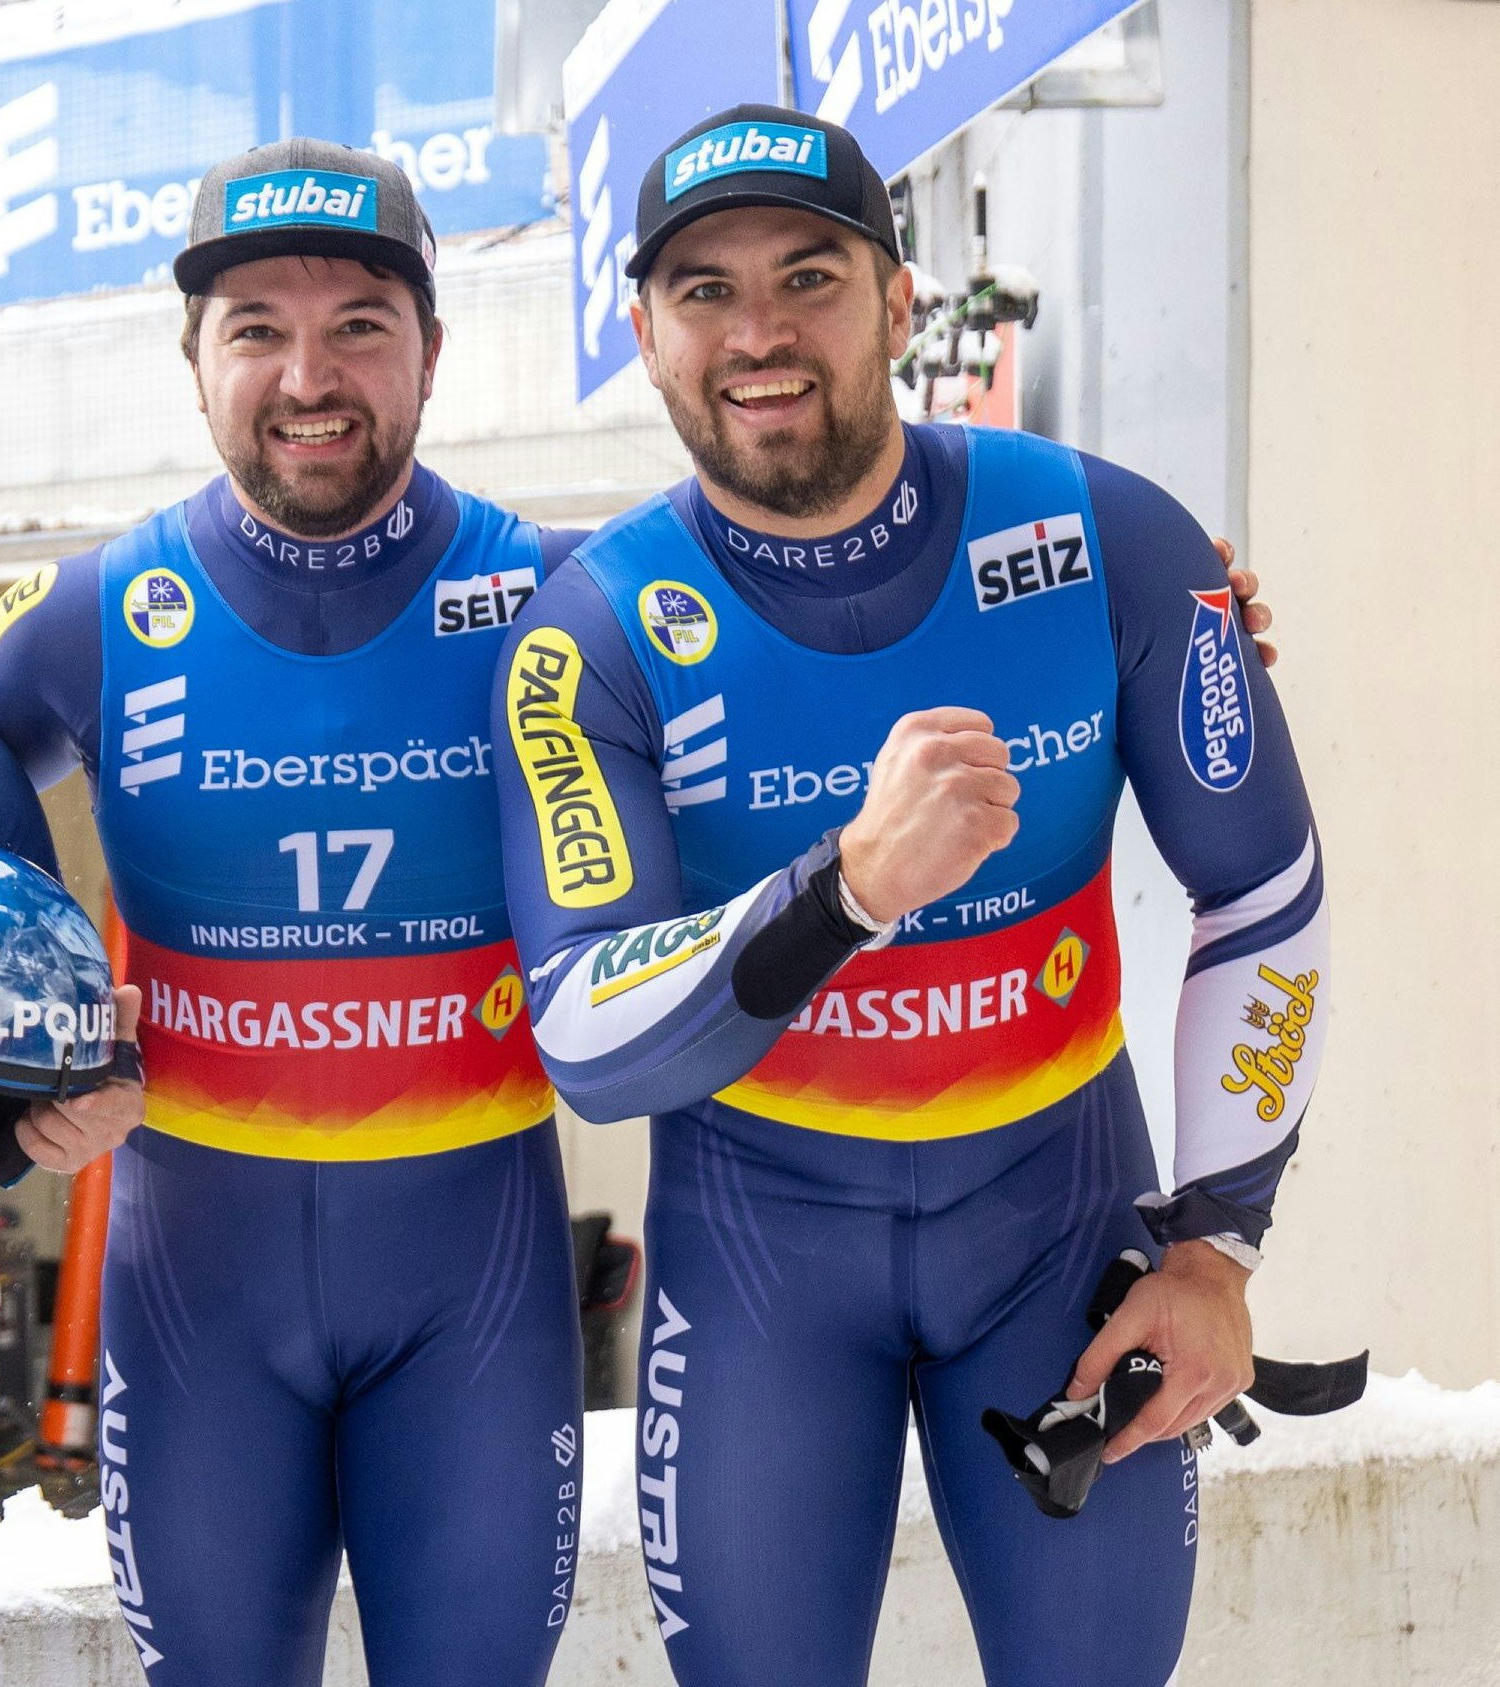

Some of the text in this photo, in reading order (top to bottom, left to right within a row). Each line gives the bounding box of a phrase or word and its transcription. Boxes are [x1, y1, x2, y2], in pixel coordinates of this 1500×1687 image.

[673, 127, 814, 187] stubai
[231, 177, 367, 224] stubai
[152, 614, 177, 629] FIL
[673, 627, 700, 645] FIL
[1194, 628, 1238, 781] personal
[1218, 651, 1245, 739] shop
[199, 735, 492, 792] Eberspäch
[516, 643, 616, 894] PALFINGER
[278, 828, 395, 912] 17
[956, 886, 1036, 926] TIROL
[190, 923, 368, 949] INNSBRUCK
[399, 915, 485, 944] TIROL
[150, 977, 468, 1050] HARGASSNER
[1220, 962, 1320, 1123] Ströck
[640, 1286, 693, 1641] AUSTRIA
[101, 1347, 165, 1669] AUSTRIA
